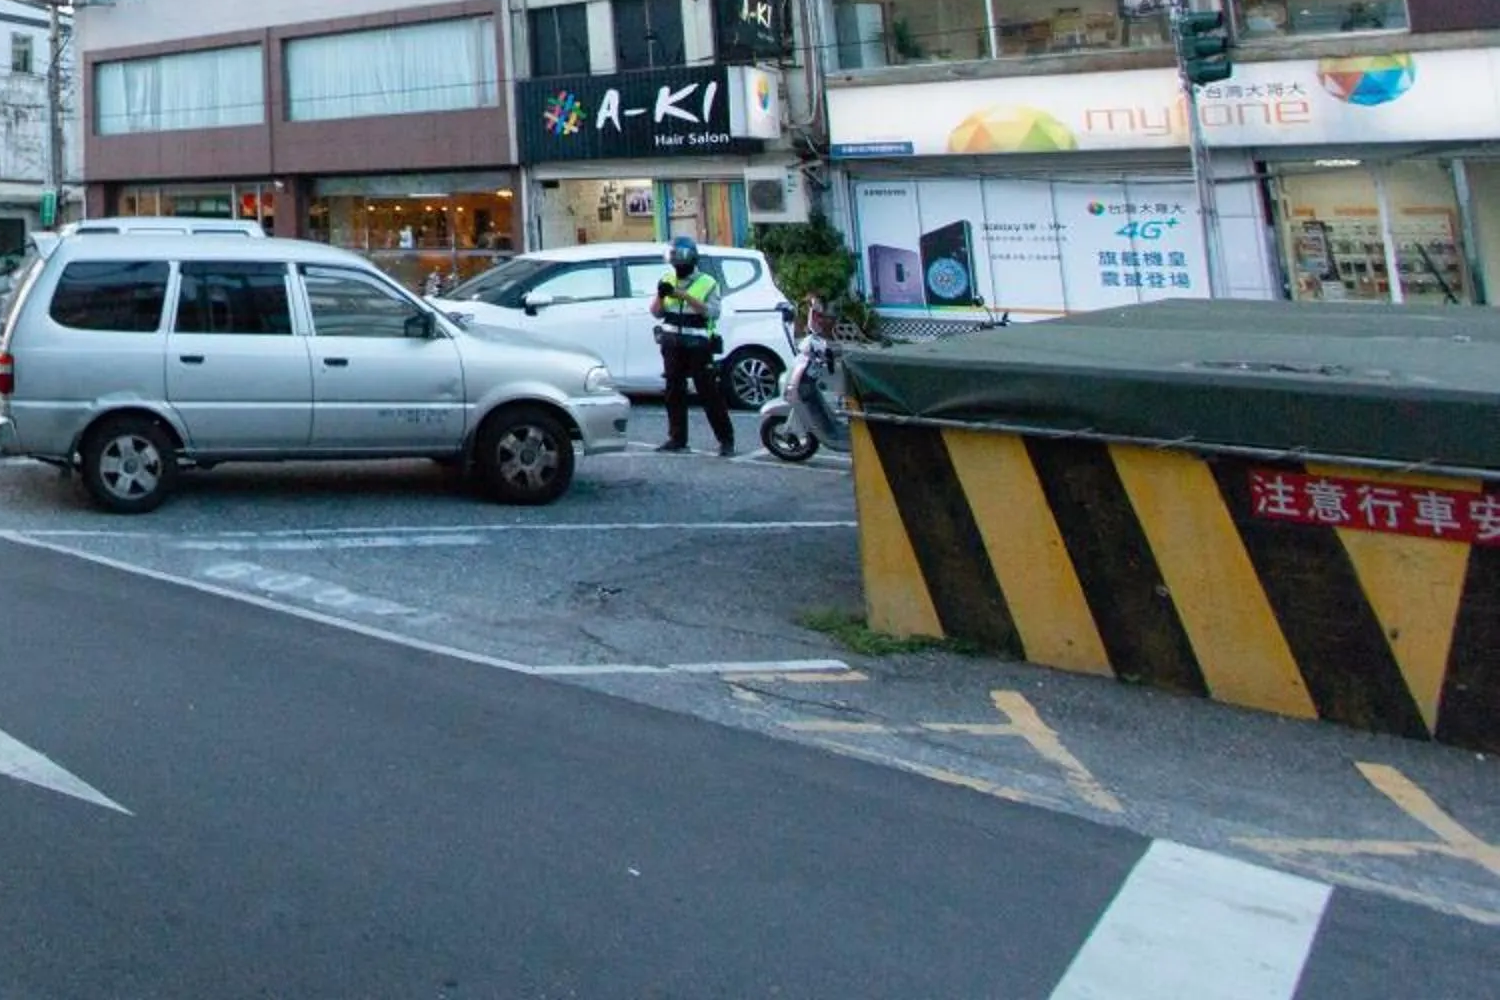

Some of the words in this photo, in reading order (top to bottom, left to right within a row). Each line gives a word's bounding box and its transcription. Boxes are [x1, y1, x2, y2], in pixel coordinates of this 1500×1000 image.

[595, 81, 717, 132] A-KI
[655, 134, 684, 146] Hair
[688, 131, 729, 145] Salon
[1253, 475, 1500, 540] 注意行車安
